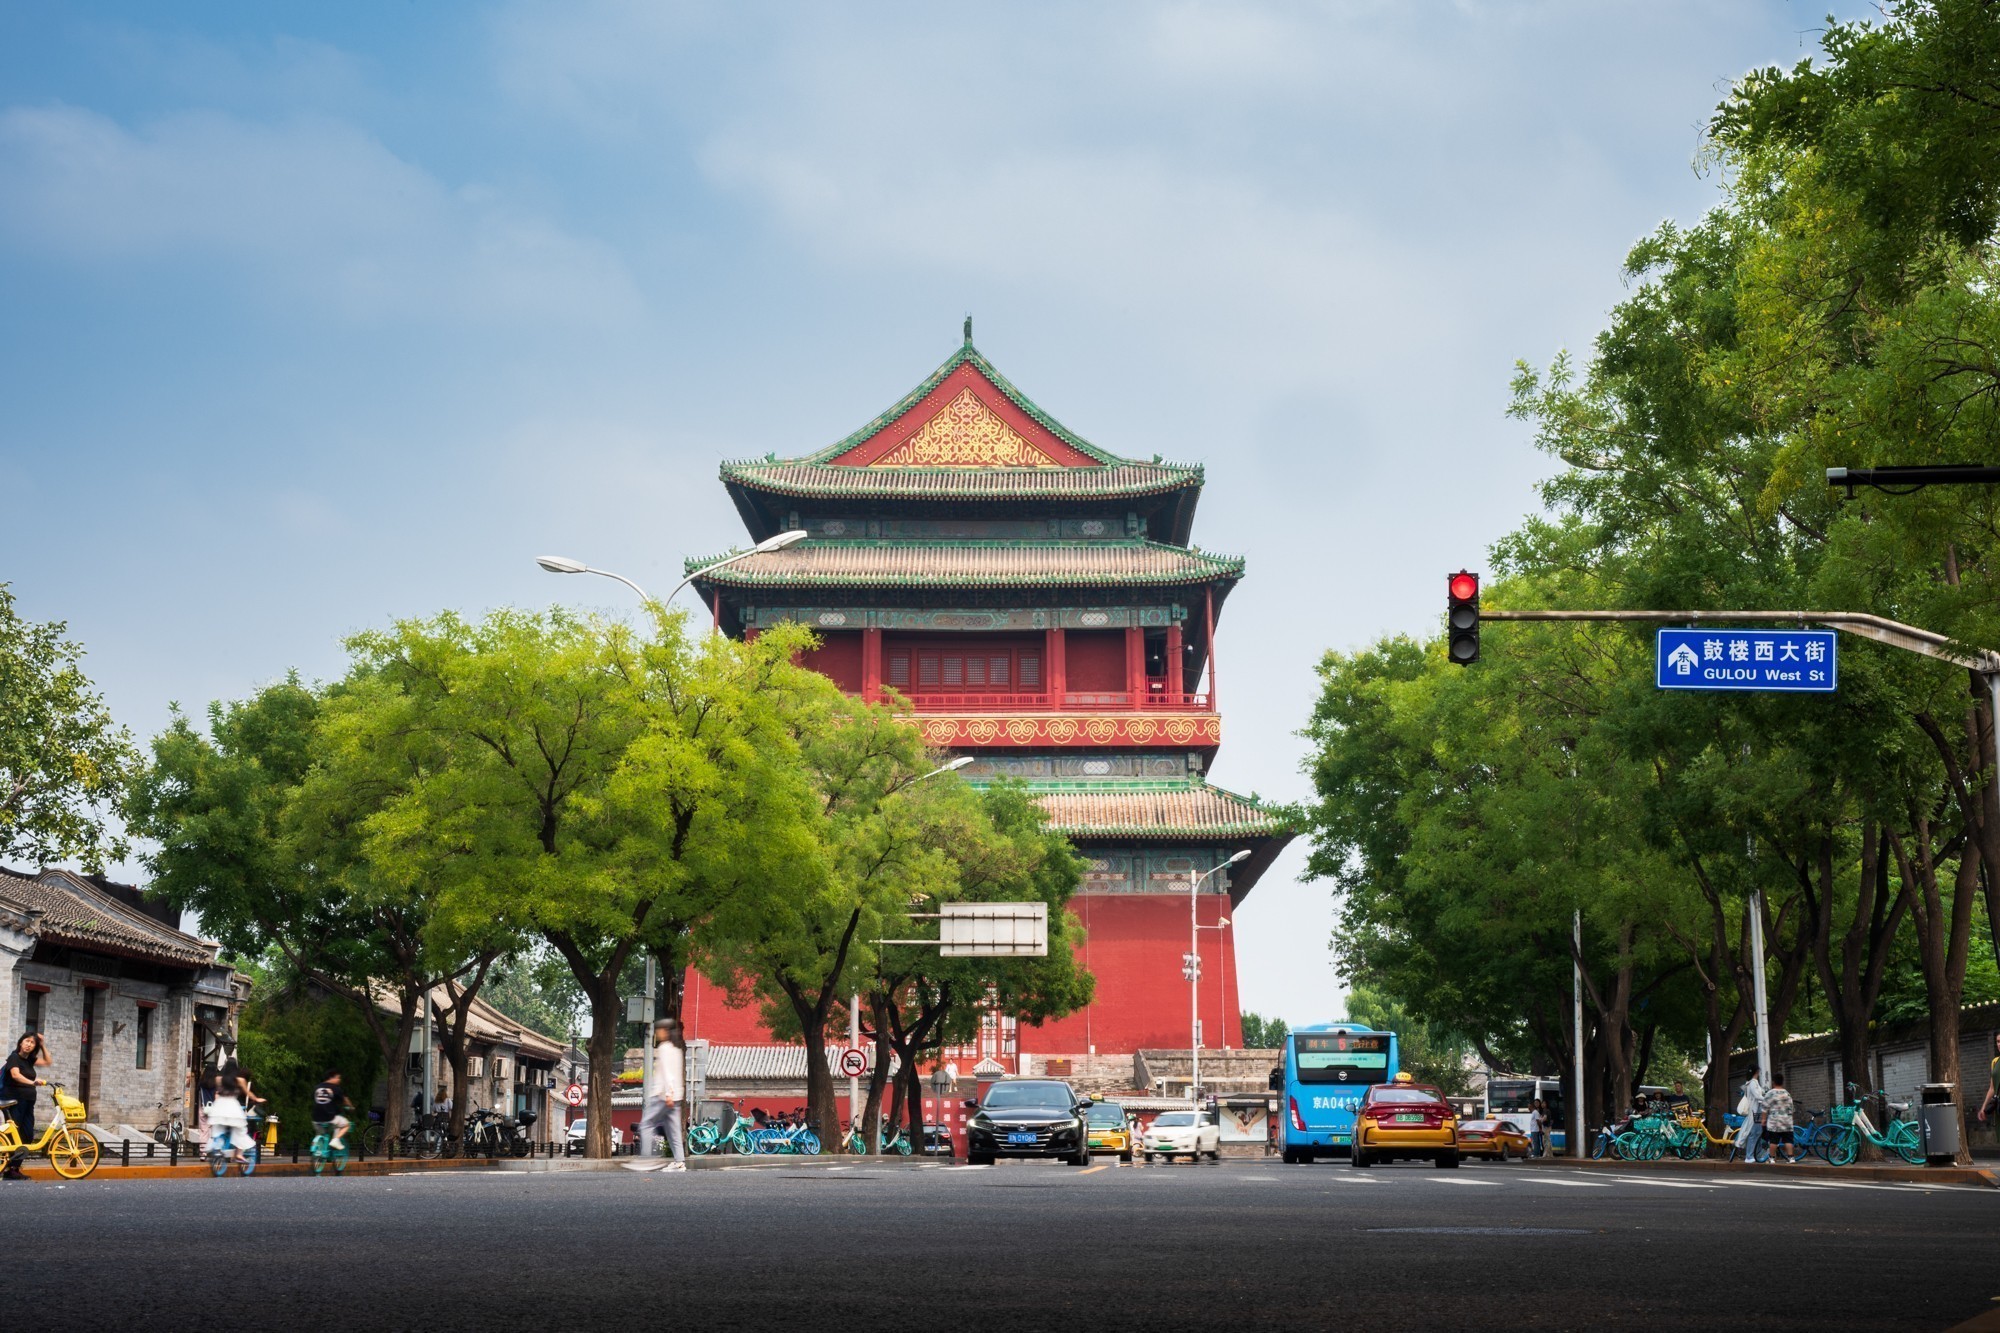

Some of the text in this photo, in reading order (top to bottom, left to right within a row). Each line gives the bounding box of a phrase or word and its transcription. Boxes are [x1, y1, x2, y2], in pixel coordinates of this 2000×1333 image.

[1677, 651, 1690, 663] 东
[1703, 639, 1826, 663] 鼓楼西大街
[1680, 664, 1688, 673] E
[1703, 668, 1825, 681] GULOU West St
[1312, 1096, 1363, 1110] 京A0412
